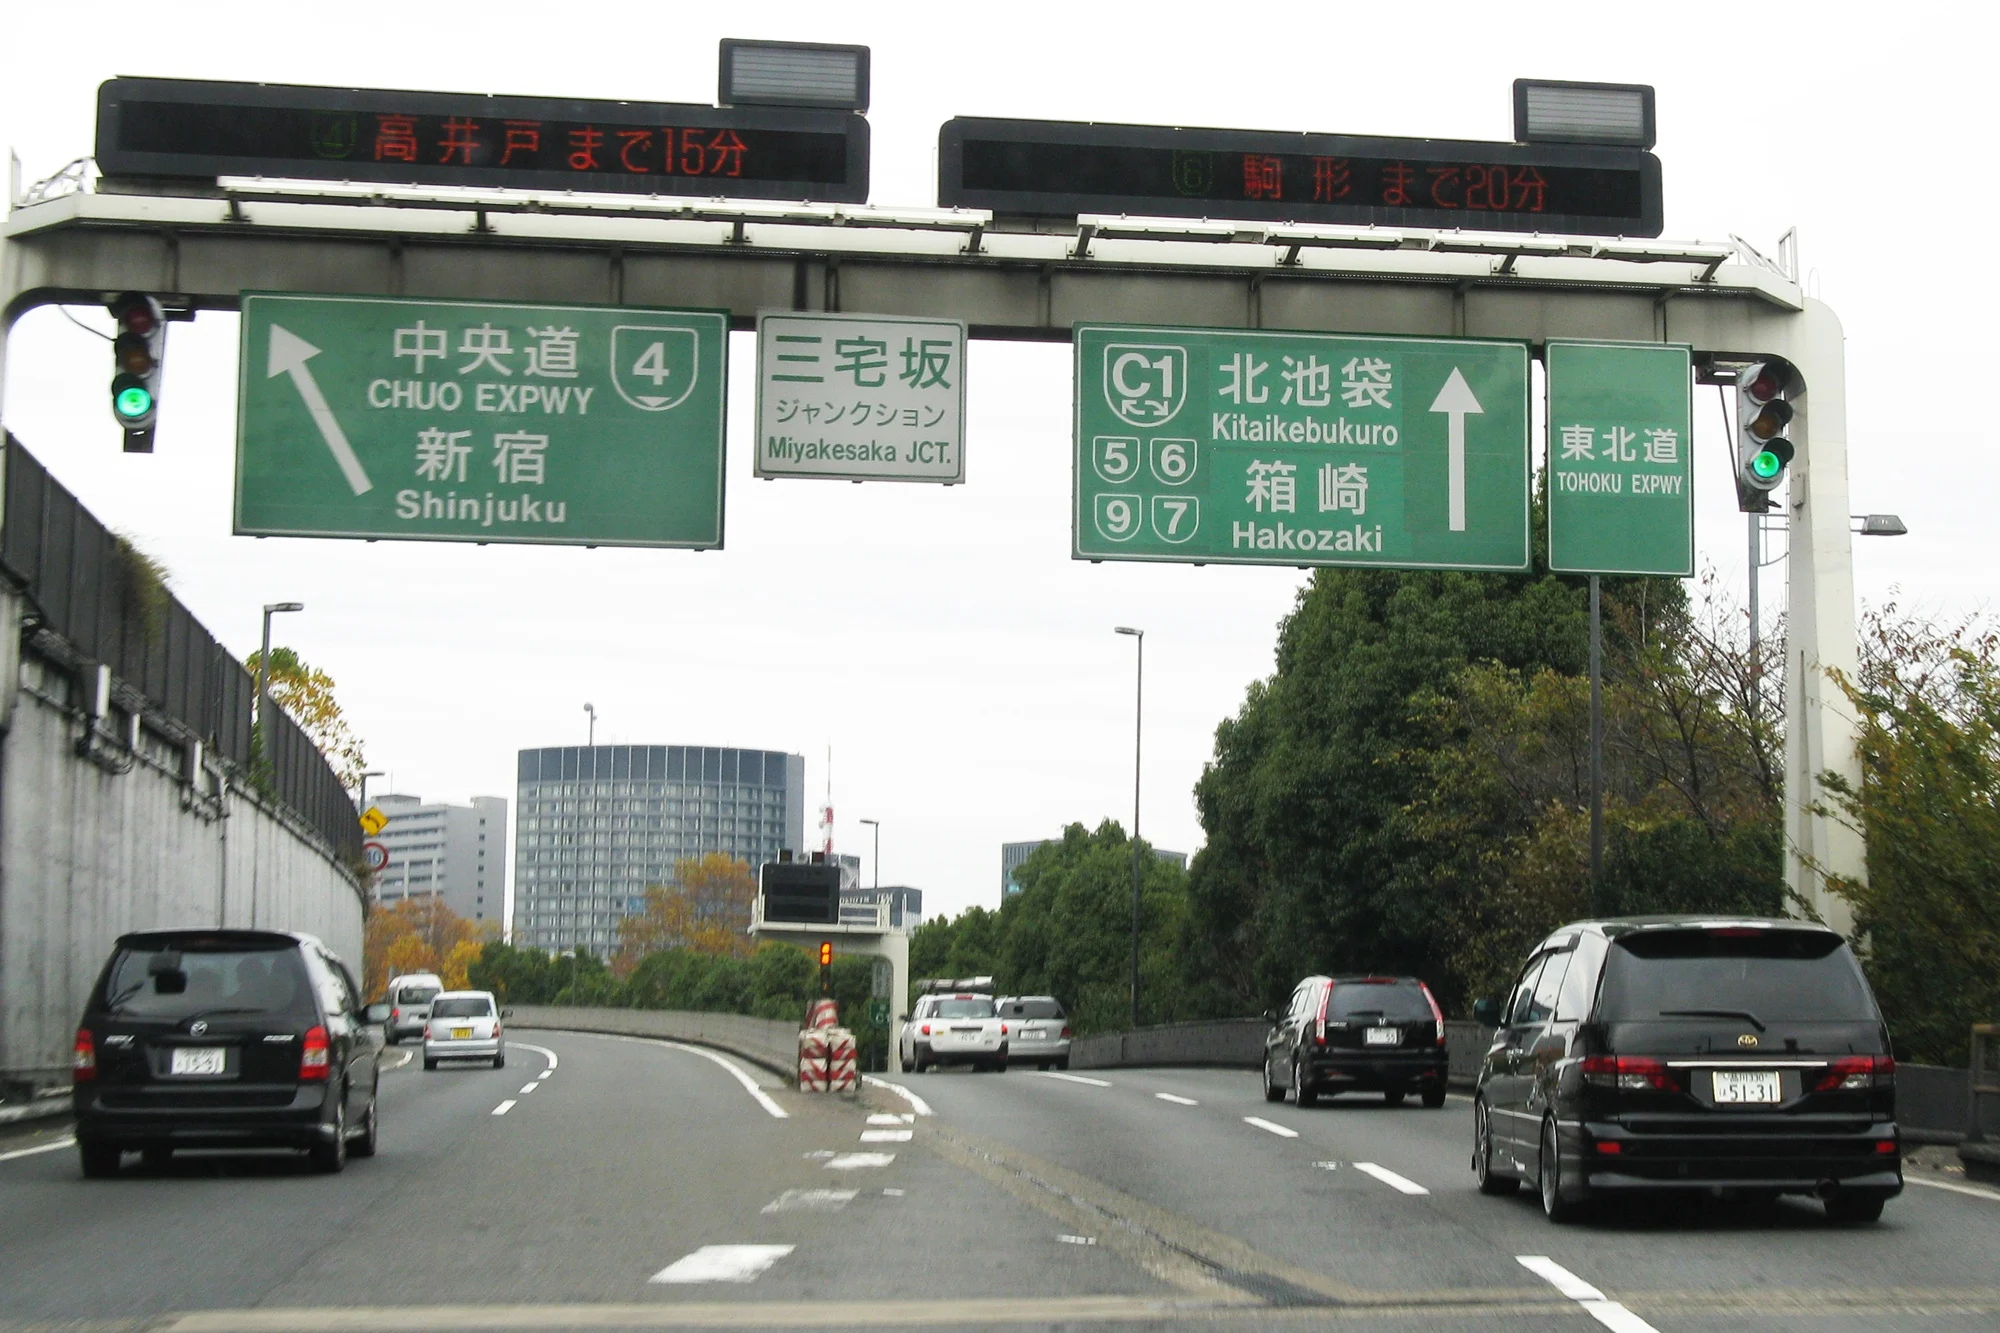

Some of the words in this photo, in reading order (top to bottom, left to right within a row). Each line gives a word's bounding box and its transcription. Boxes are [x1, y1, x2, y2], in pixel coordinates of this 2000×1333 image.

[393, 319, 581, 379] 中央道
[631, 341, 670, 386] 4
[771, 335, 953, 390] 三宅坂
[1112, 352, 1173, 398] C1
[1218, 352, 1393, 409] 北池袋
[367, 378, 463, 412] CHUO
[475, 383, 594, 415] EXPWY
[776, 399, 945, 428] ジャンクション
[1212, 412, 1399, 446] Kitaikebukuro
[1559, 424, 1678, 464] 東北道
[415, 426, 549, 485] 新宿
[768, 436, 897, 464] Miyakesaka
[905, 440, 951, 464] JCT.
[1103, 442, 1129, 475] 5
[1160, 444, 1187, 477] 6
[1245, 459, 1369, 516] 箱崎
[1557, 472, 1622, 494] TOHOKU
[1632, 474, 1683, 495] EXPWY
[395, 488, 567, 527] Shinjuku
[1105, 500, 1132, 533] 9
[1163, 501, 1188, 535] 7
[1232, 521, 1383, 552] Hakozaki
